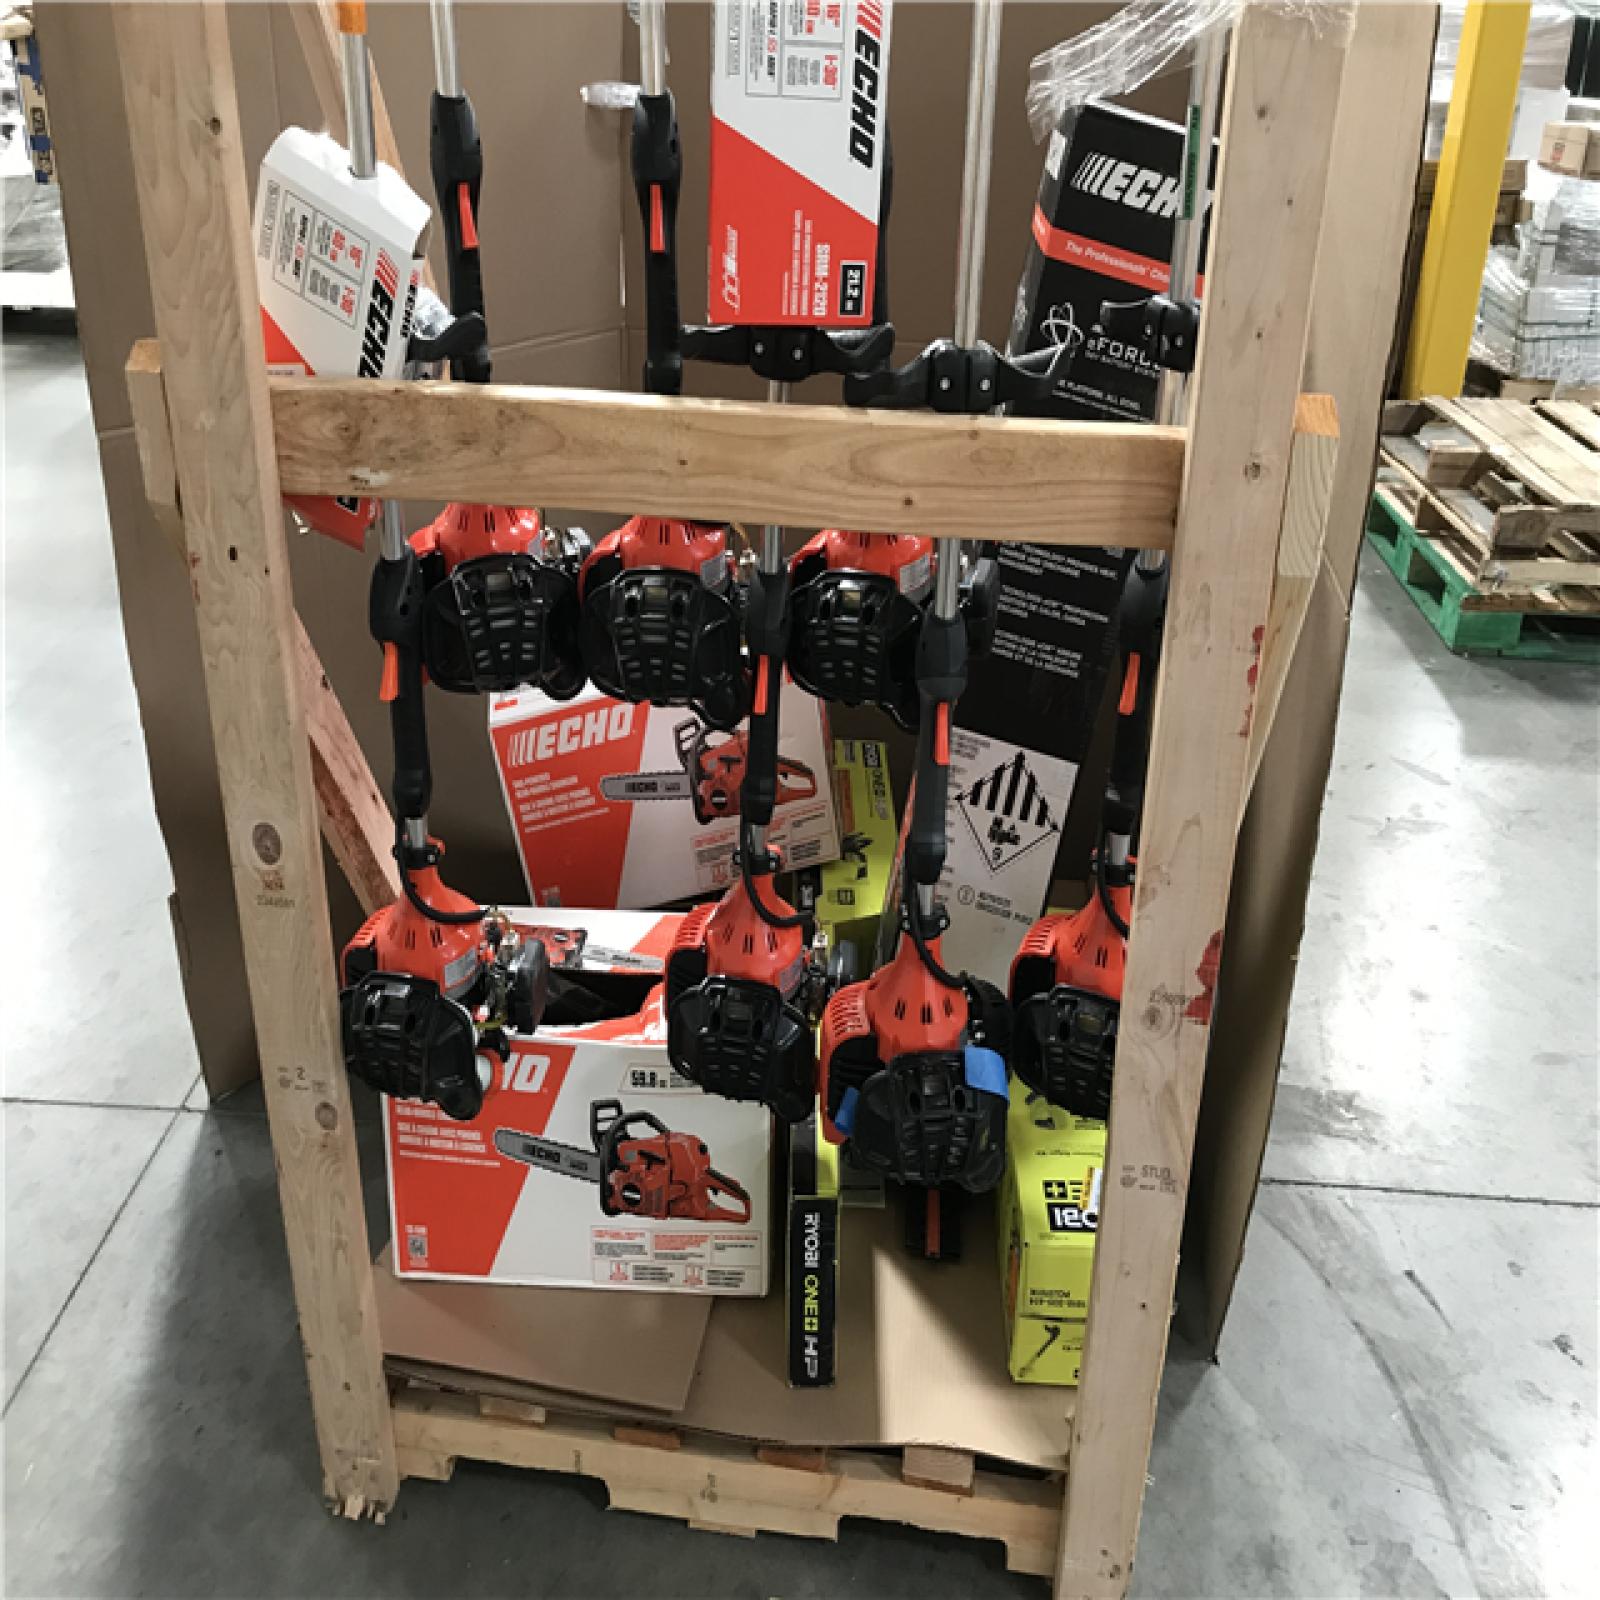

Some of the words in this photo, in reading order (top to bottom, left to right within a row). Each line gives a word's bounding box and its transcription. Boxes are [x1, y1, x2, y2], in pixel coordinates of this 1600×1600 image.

[849, 29, 880, 169] ECHO
[1065, 239, 1082, 256] The
[847, 269, 861, 298] 21.2
[536, 704, 634, 761] ECHO
[804, 1212, 820, 1269] RYOBI
[804, 1274, 819, 1332] ONE+
[804, 1335, 819, 1379] HP
